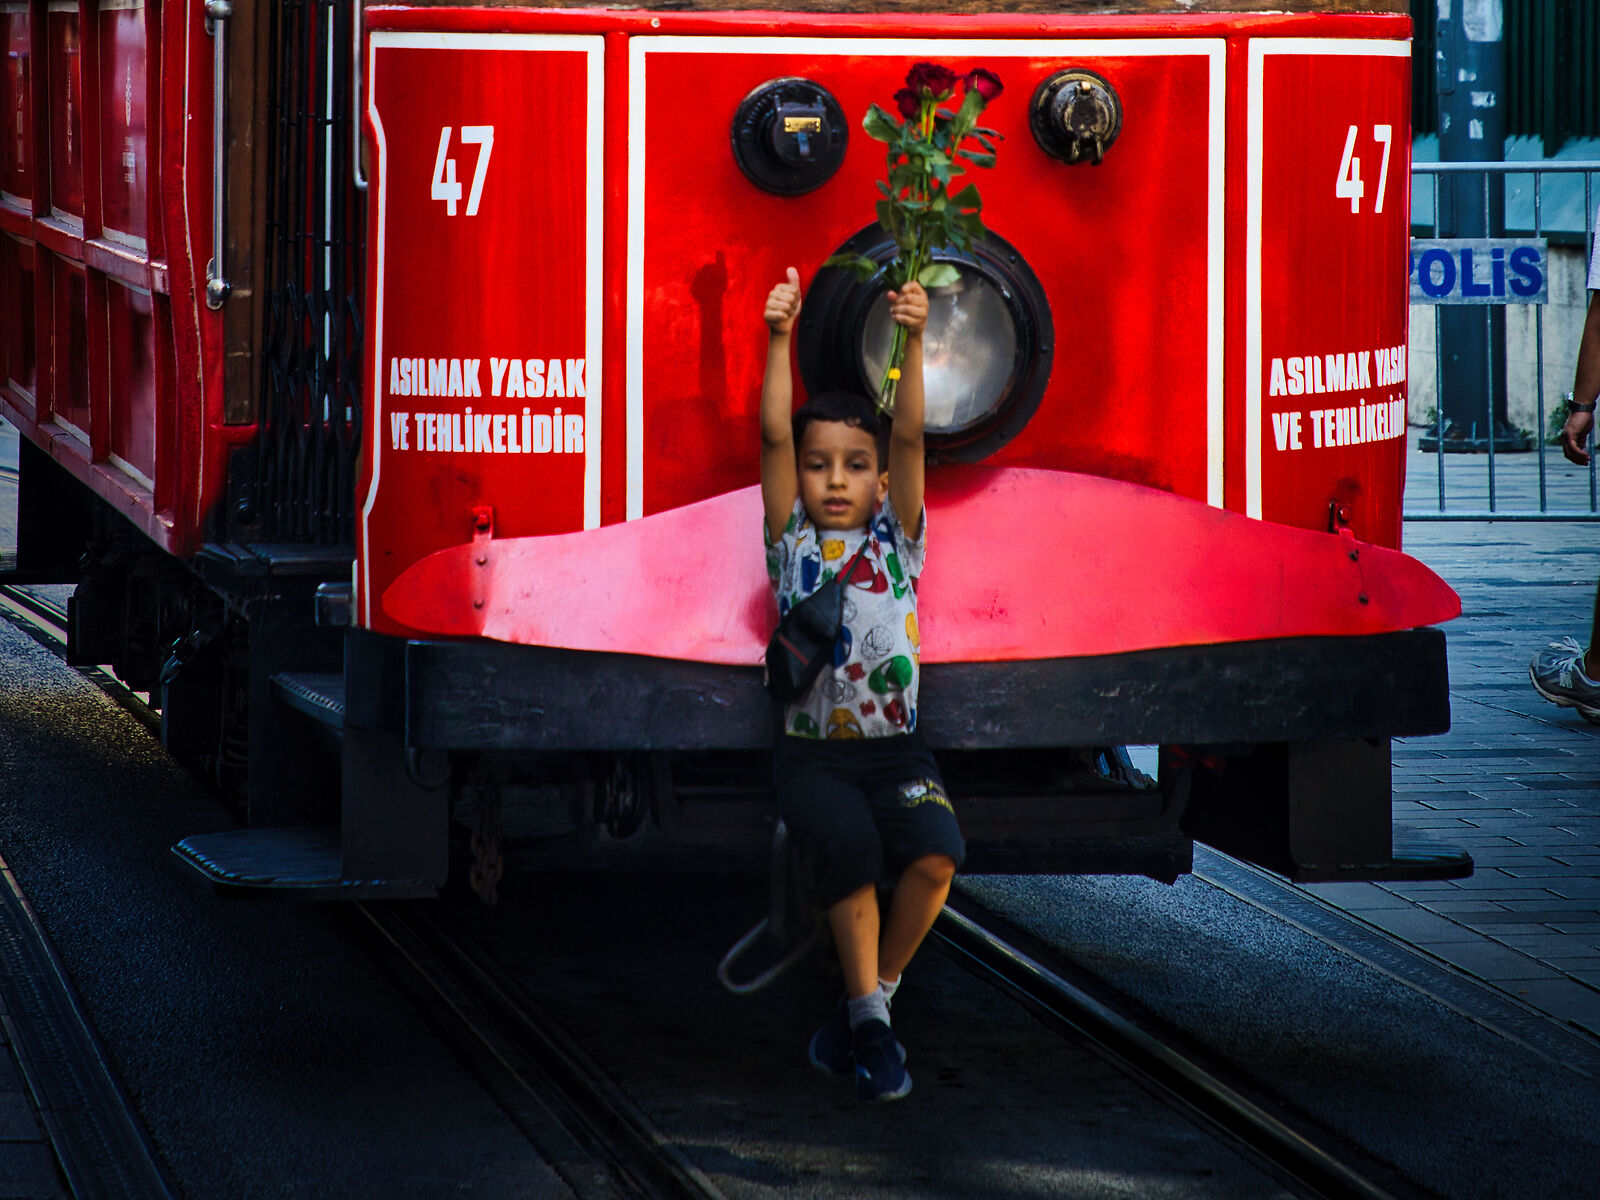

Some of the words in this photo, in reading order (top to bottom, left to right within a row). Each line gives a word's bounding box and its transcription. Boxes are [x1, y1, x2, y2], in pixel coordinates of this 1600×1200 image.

[431, 125, 495, 217] 47
[1335, 124, 1392, 214] 47
[1411, 247, 1543, 298] OLİS
[389, 357, 482, 397] ASILMAK
[489, 356, 585, 398] YASAK
[1269, 350, 1371, 396] ASILMAK
[390, 412, 409, 451] VE
[414, 406, 584, 454] TEHLİKELİDİR
[1271, 411, 1303, 451] VE
